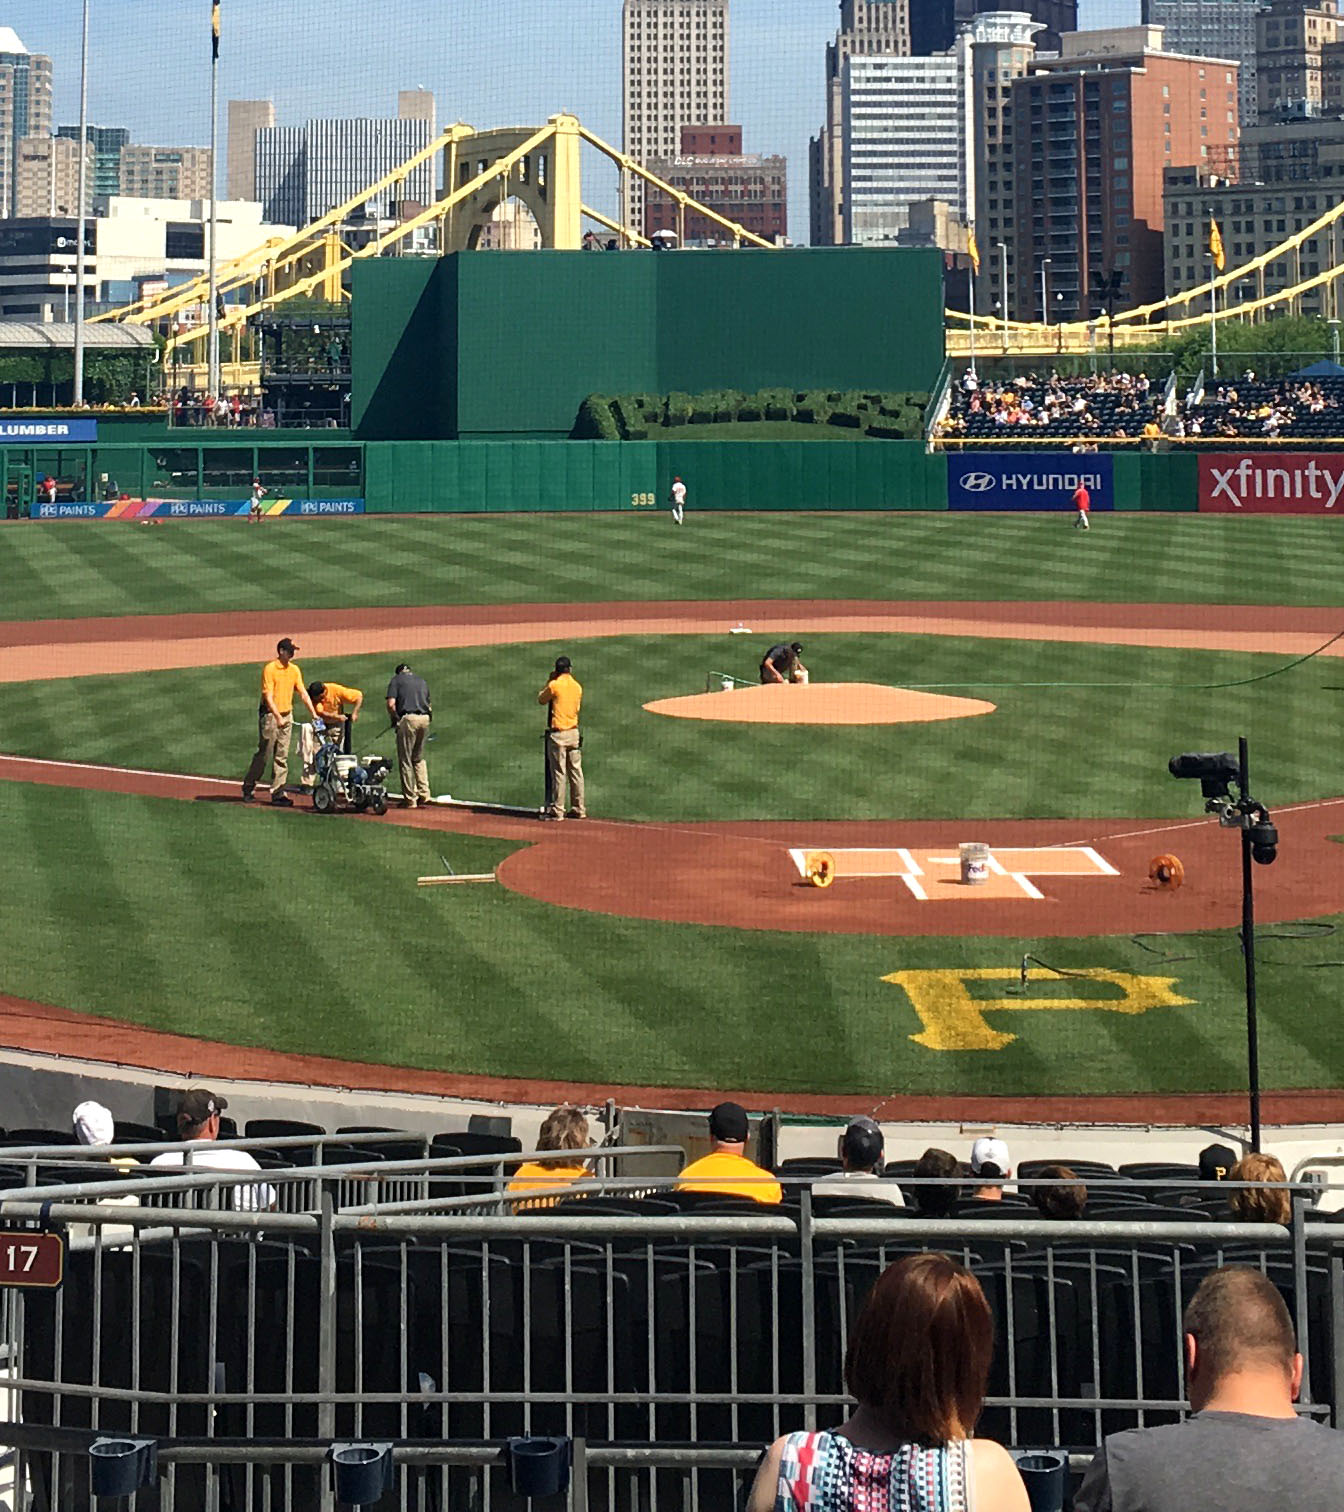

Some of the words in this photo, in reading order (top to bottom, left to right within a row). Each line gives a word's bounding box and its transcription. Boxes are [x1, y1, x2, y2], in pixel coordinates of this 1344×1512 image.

[1002, 474, 1102, 491] HYUNDAI
[631, 493, 656, 506] 399
[59, 505, 96, 516] PAINTS
[190, 504, 226, 515] PAINTS
[319, 502, 355, 513] PAINTS
[879, 967, 1199, 1051] P
[1216, 1166, 1227, 1181] P
[5, 1245, 39, 1274] 17
